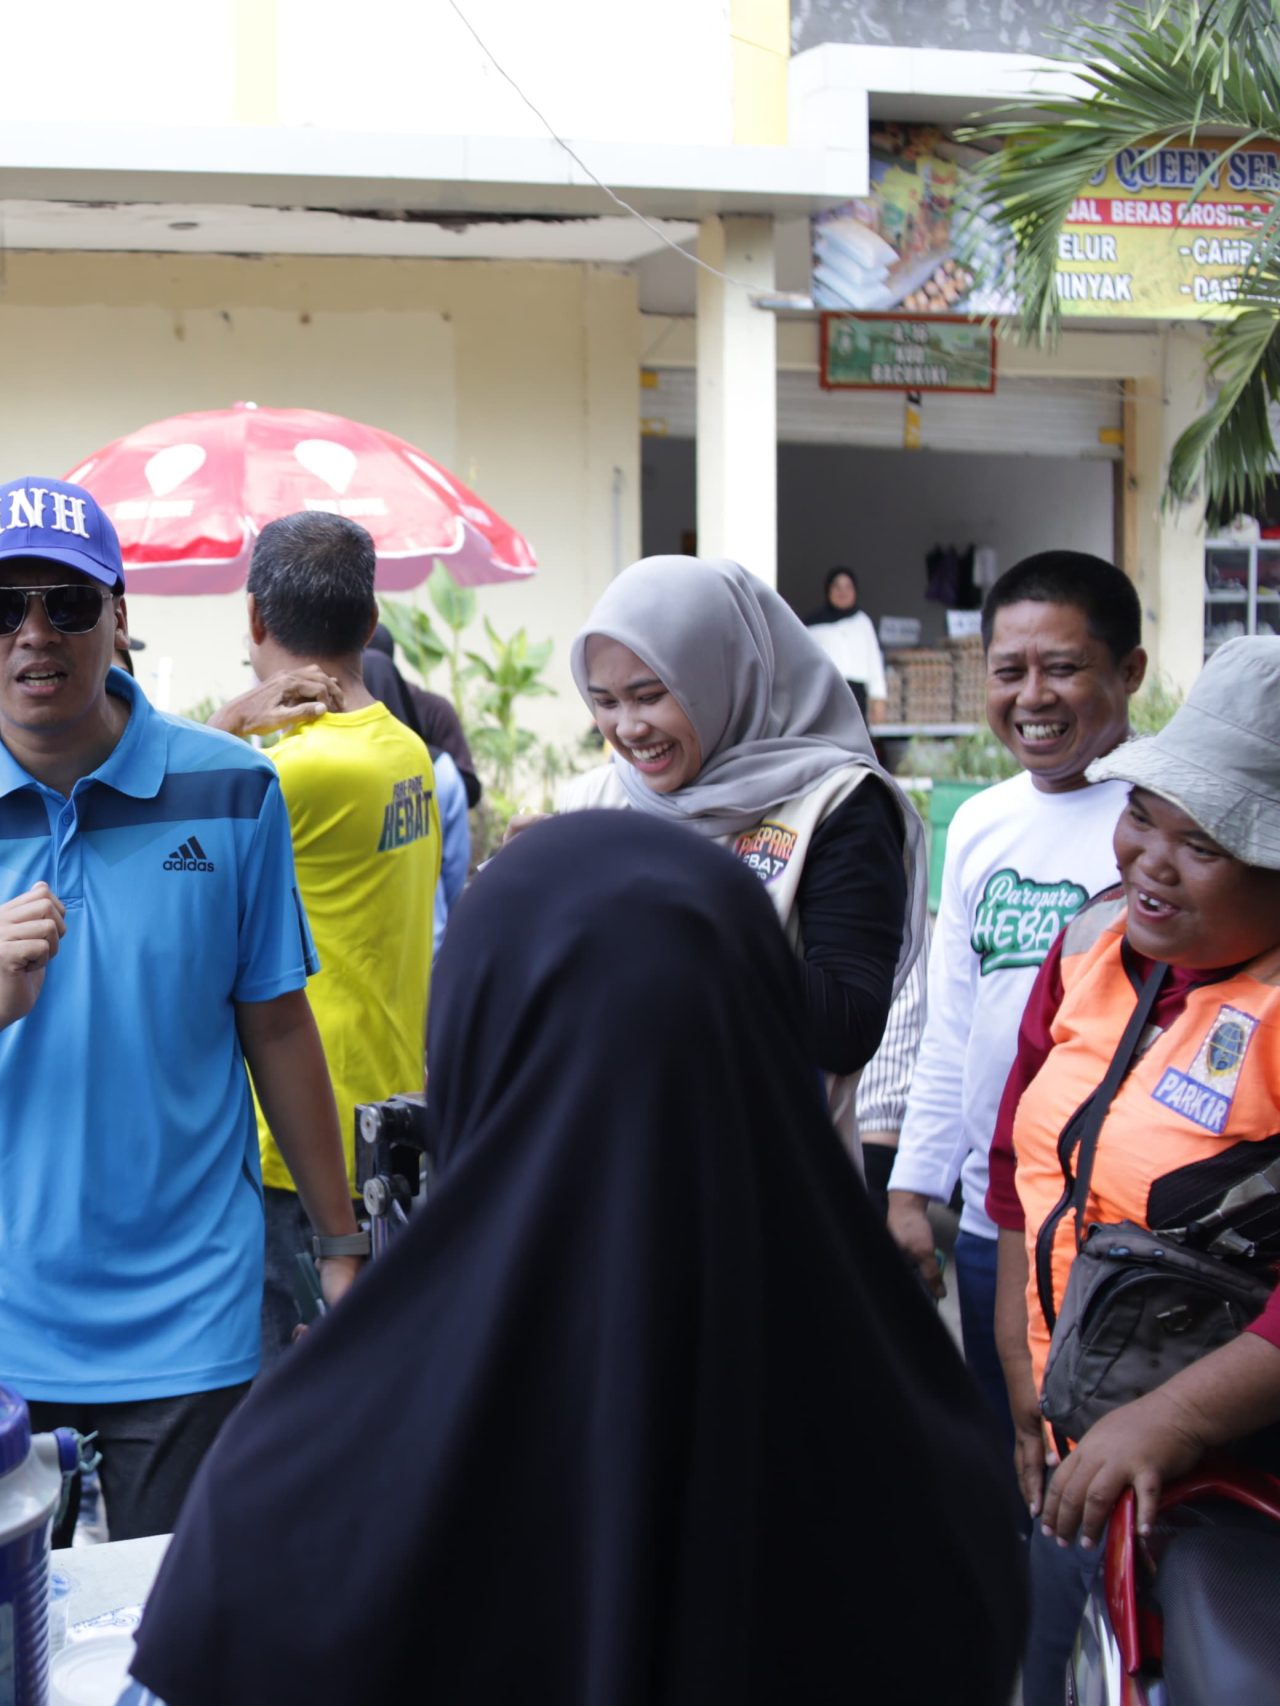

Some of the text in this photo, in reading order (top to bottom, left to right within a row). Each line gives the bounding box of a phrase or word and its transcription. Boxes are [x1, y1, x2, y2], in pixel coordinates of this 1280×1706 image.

[1115, 148, 1220, 193] QUEEN
[1111, 201, 1172, 225] BERAS
[1177, 202, 1246, 227] GROSIR
[1058, 233, 1117, 262] ELUR
[377, 790, 433, 852] HEBAT
[162, 858, 215, 872] adidas
[988, 875, 1080, 910] Parepare
[1155, 1071, 1229, 1131] PARKIR
